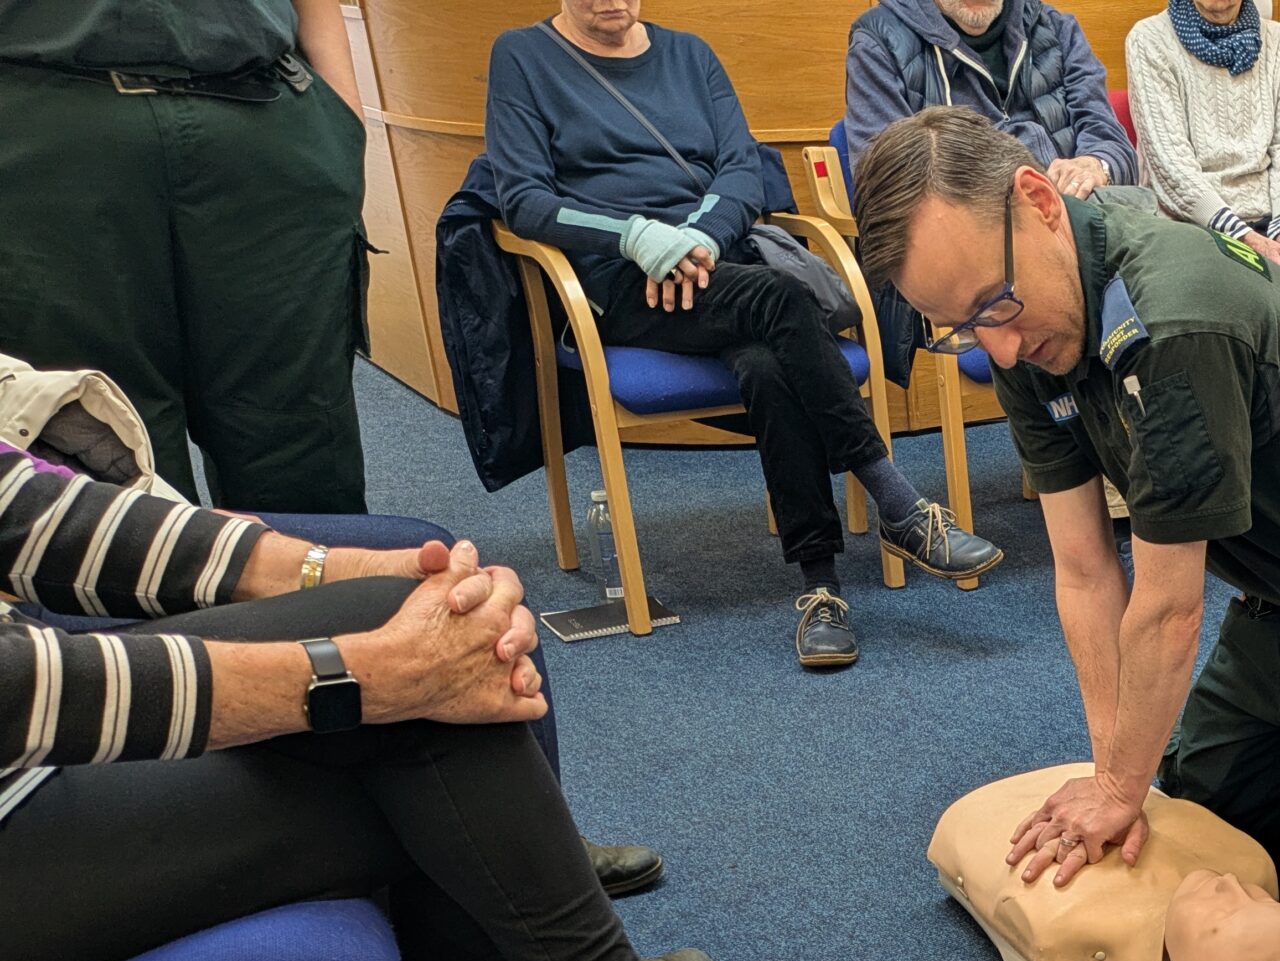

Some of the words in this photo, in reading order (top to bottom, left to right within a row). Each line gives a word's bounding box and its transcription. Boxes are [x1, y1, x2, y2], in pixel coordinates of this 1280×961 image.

[1100, 316, 1135, 354] COMMUNITY
[1105, 328, 1139, 364] RESPONDER
[1108, 330, 1124, 349] FIRST
[1049, 395, 1079, 419] NH
